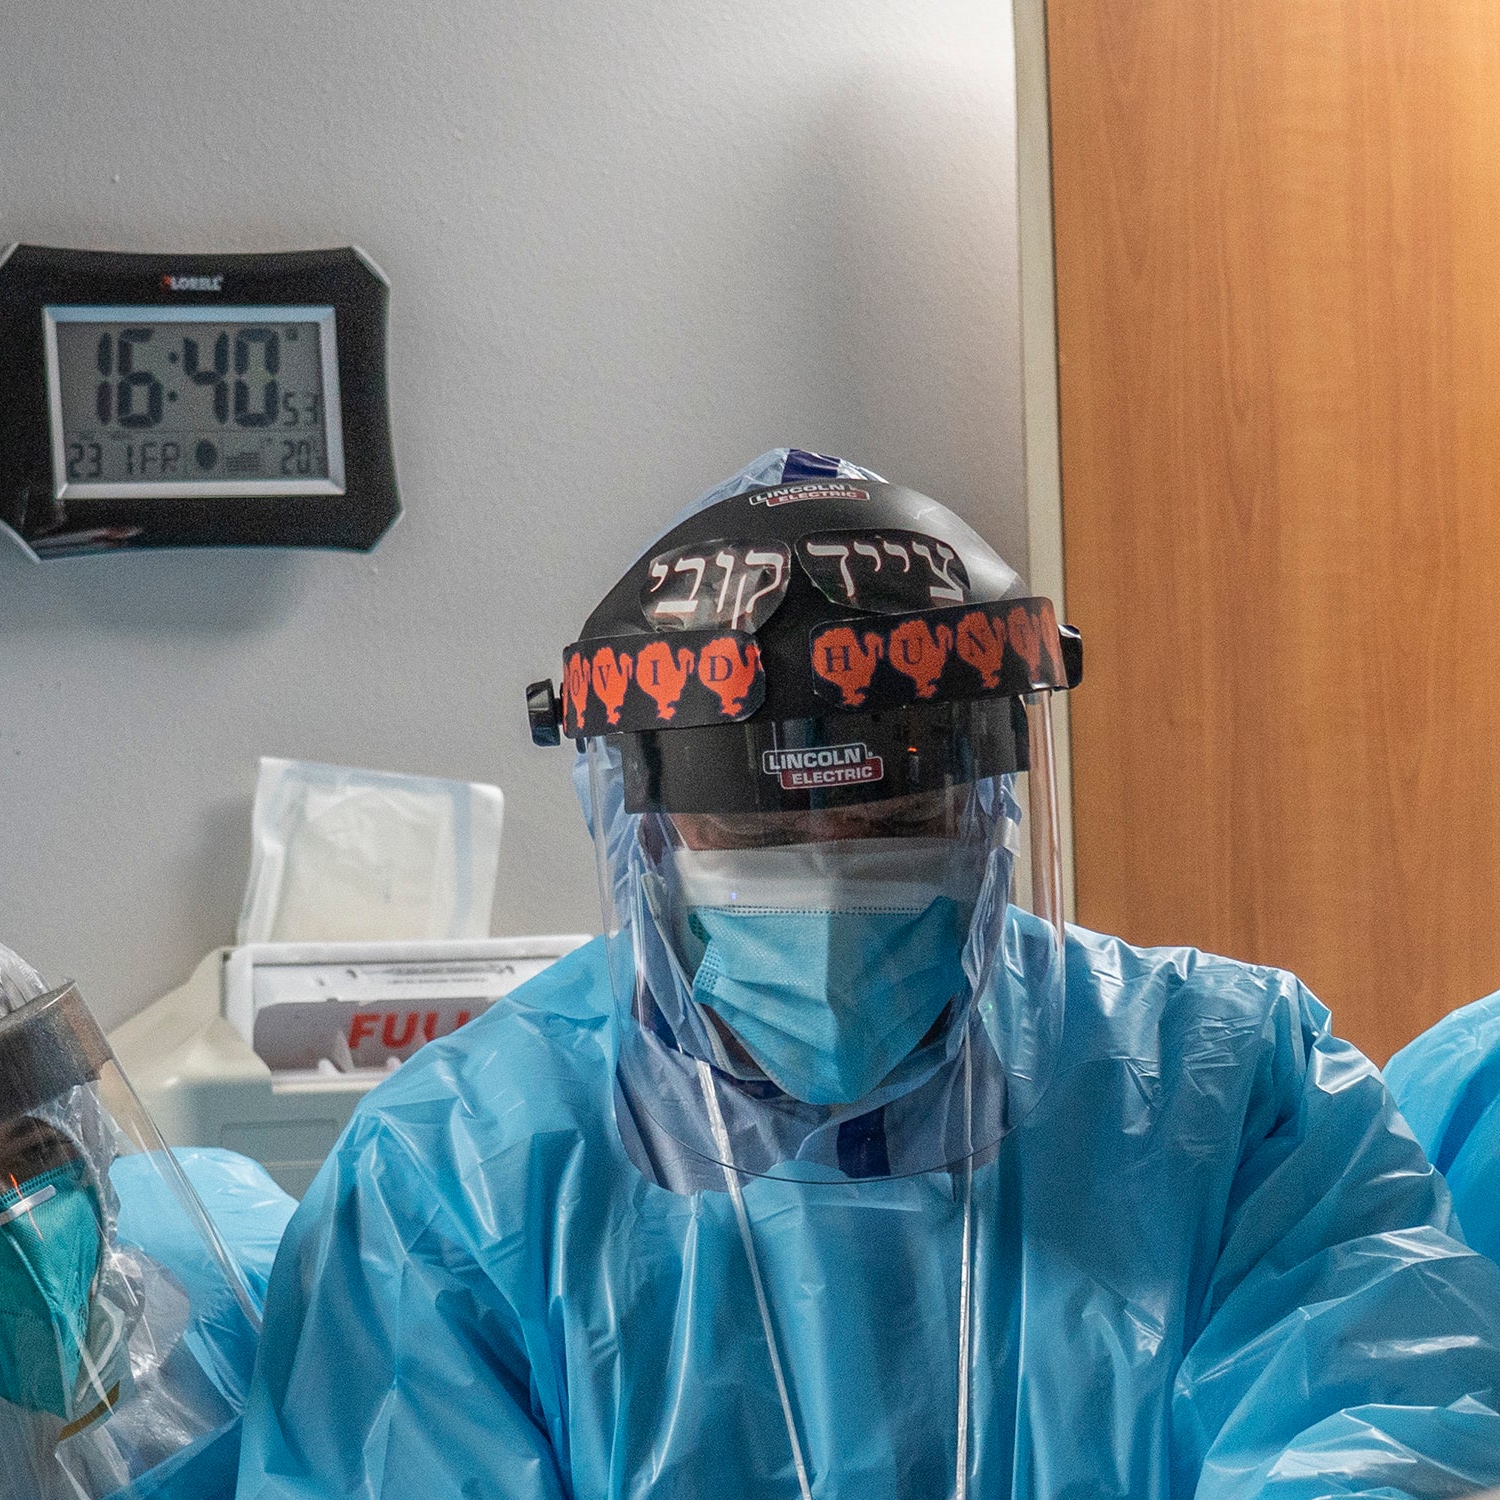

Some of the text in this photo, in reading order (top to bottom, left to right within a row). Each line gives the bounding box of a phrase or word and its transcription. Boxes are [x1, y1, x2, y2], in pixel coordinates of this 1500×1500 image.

[97, 328, 279, 428] 16:40
[756, 484, 844, 501] LINCOLN
[778, 490, 857, 503] ELECTRIC
[769, 747, 861, 770] LINCOLN
[792, 766, 873, 785] ELECTRIC
